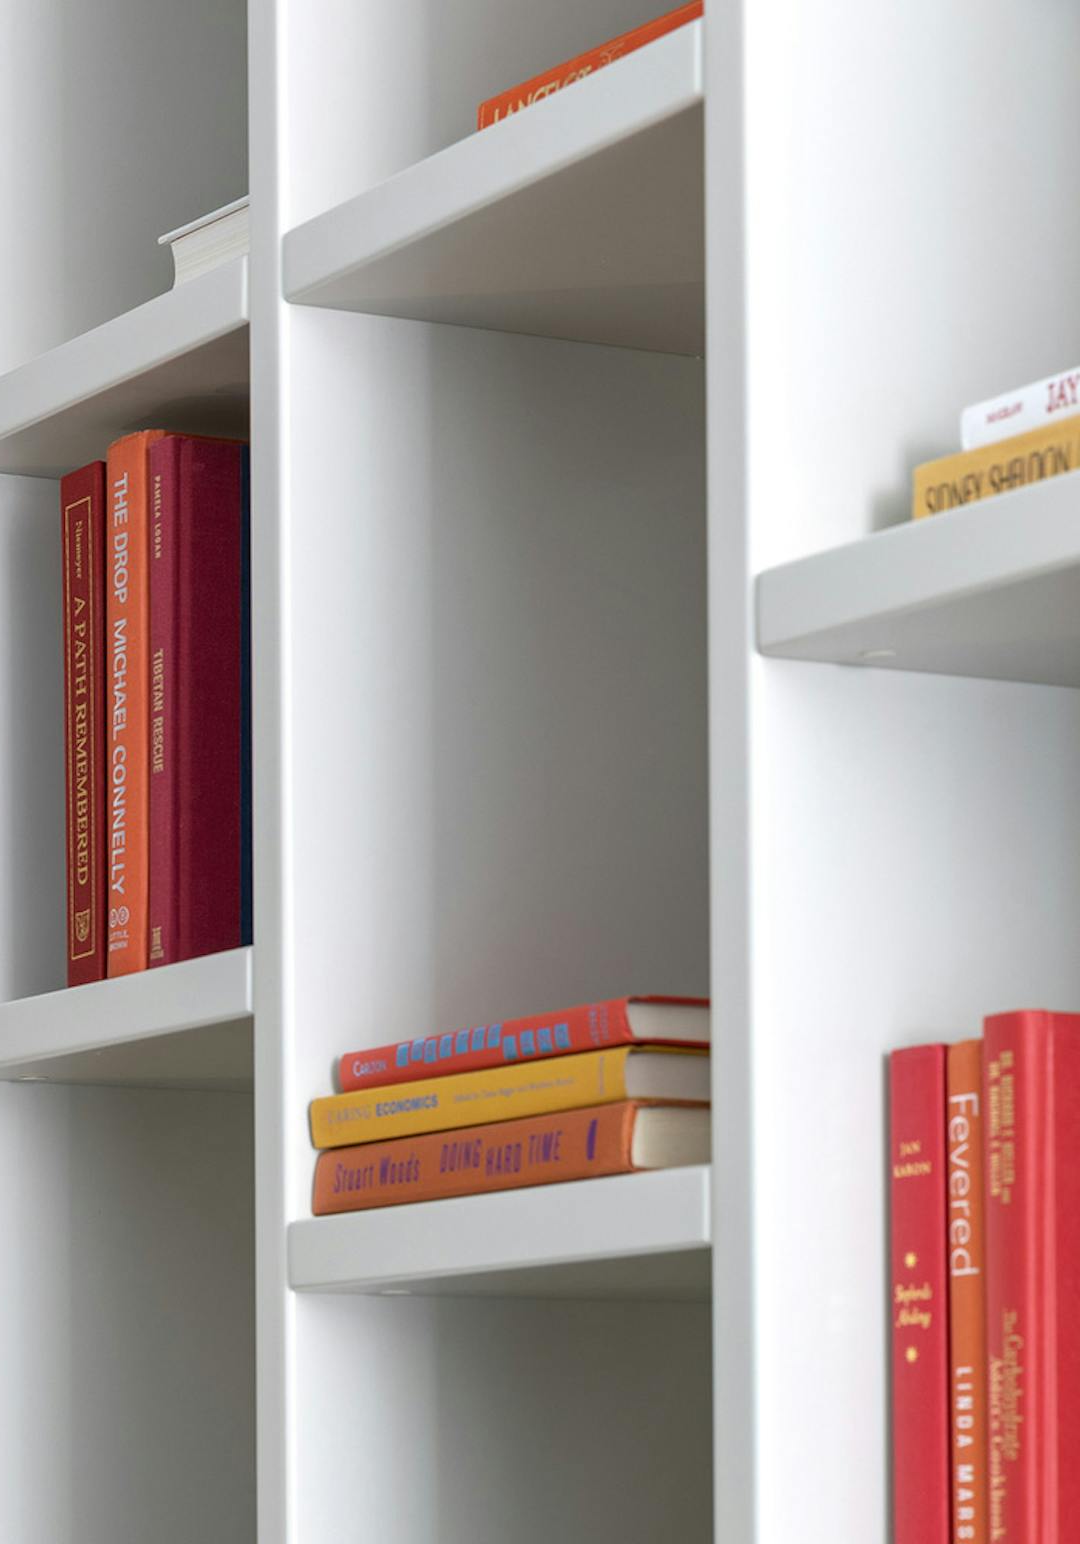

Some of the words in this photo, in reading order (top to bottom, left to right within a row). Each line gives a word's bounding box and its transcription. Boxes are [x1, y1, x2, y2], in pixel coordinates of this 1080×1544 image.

[113, 472, 128, 528] THE
[154, 474, 162, 519] PAMELA
[113, 531, 129, 604] DROP
[154, 522, 162, 559] LOGAN
[74, 596, 86, 616] A
[74, 623, 88, 696] PATH
[112, 617, 128, 741] MICHAEL
[153, 647, 164, 712] TIBETAN
[152, 716, 164, 774] RESCUE
[75, 703, 89, 886] REMEMBERED
[111, 744, 127, 895] CONNELLY
[375, 1093, 439, 1118] ECONOMICS
[528, 1130, 563, 1166] TIME
[948, 1092, 981, 1277] Fevered
[955, 1366, 975, 1449] LINDA
